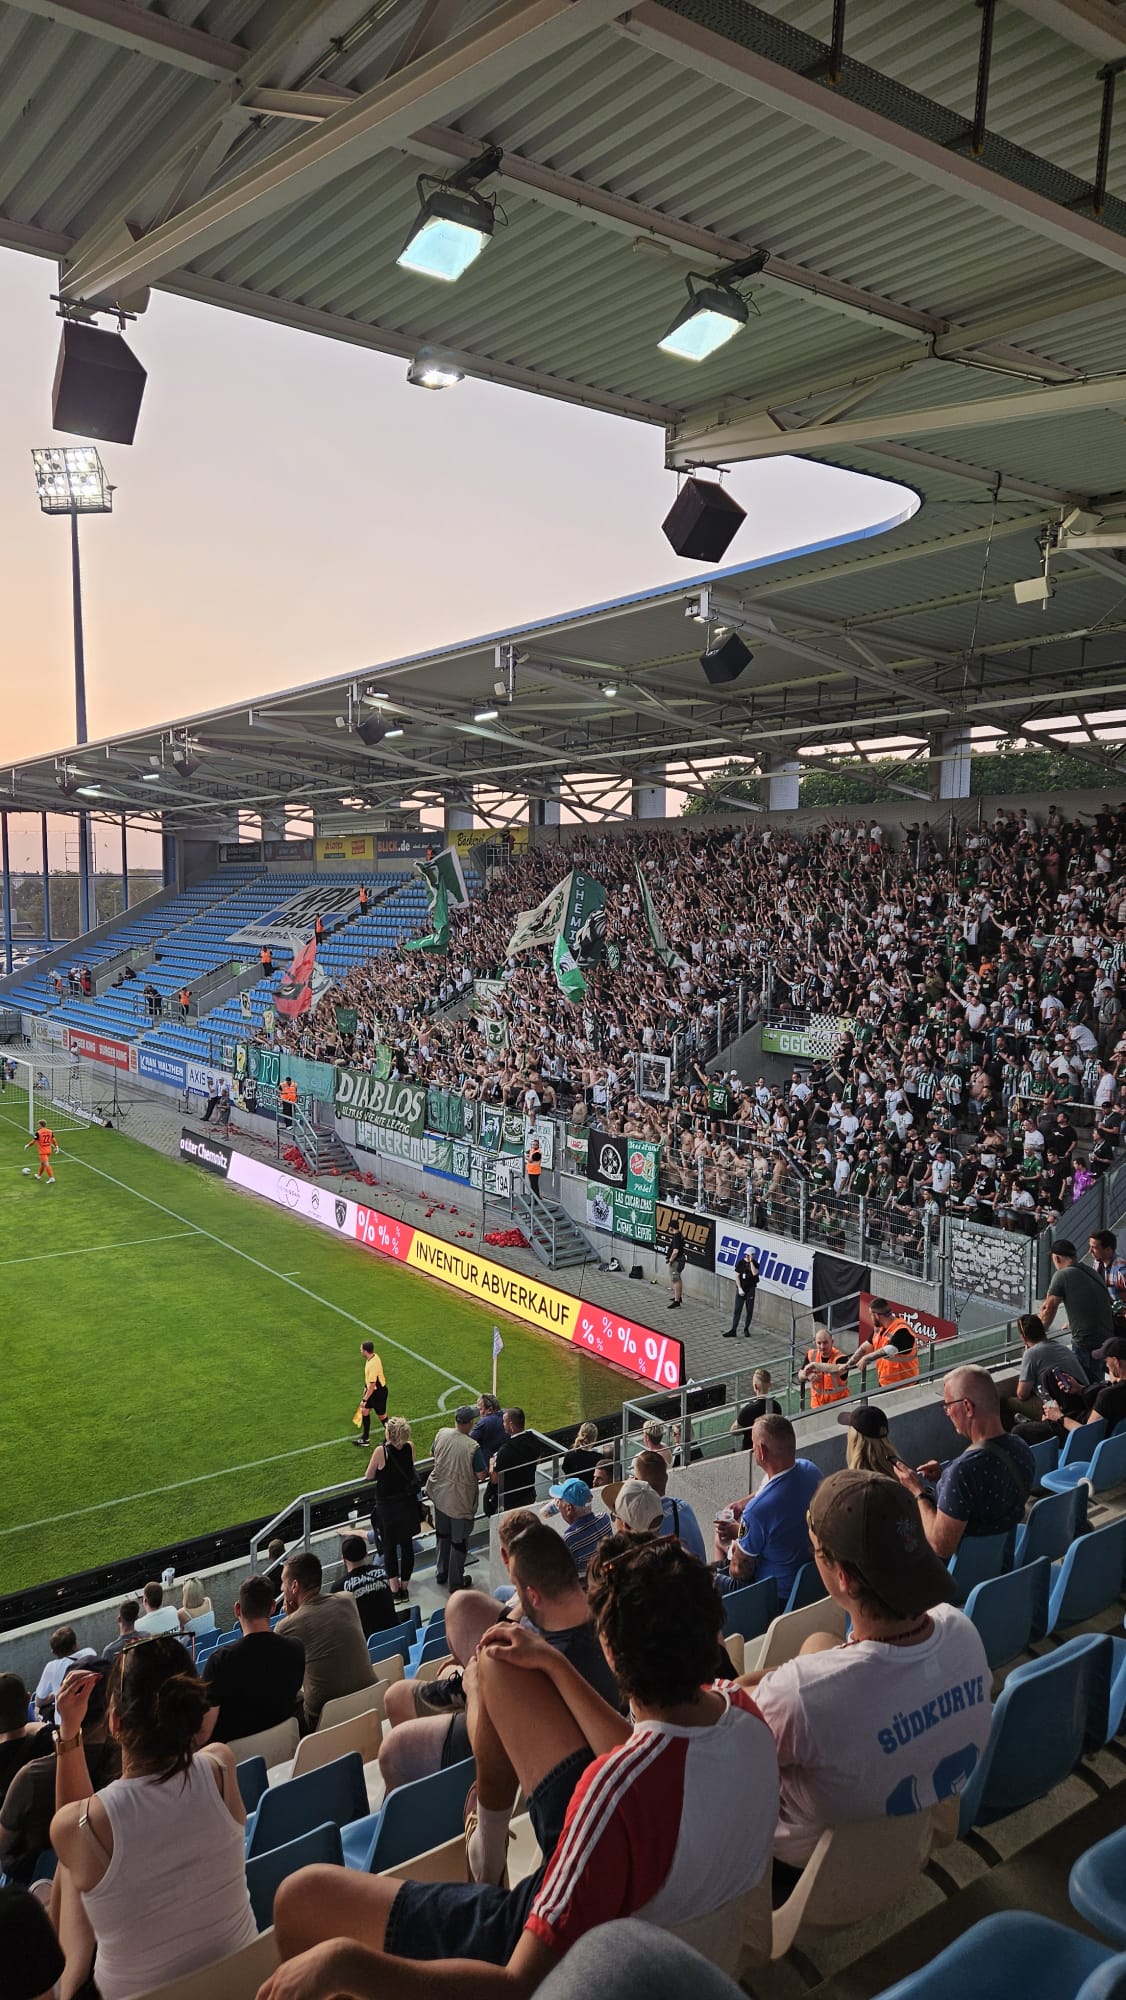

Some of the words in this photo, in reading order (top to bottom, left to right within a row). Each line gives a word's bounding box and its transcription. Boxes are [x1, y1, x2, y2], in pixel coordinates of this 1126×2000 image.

[336, 1072, 426, 1122] DIABLOS
[198, 1143, 228, 1169] Chemnitz
[497, 1176, 509, 1193] 19A
[415, 1239, 479, 1286] INVENTUR
[481, 1270, 571, 1326] ABVERKAUF
[877, 1675, 984, 1755] SÜDKURVE
